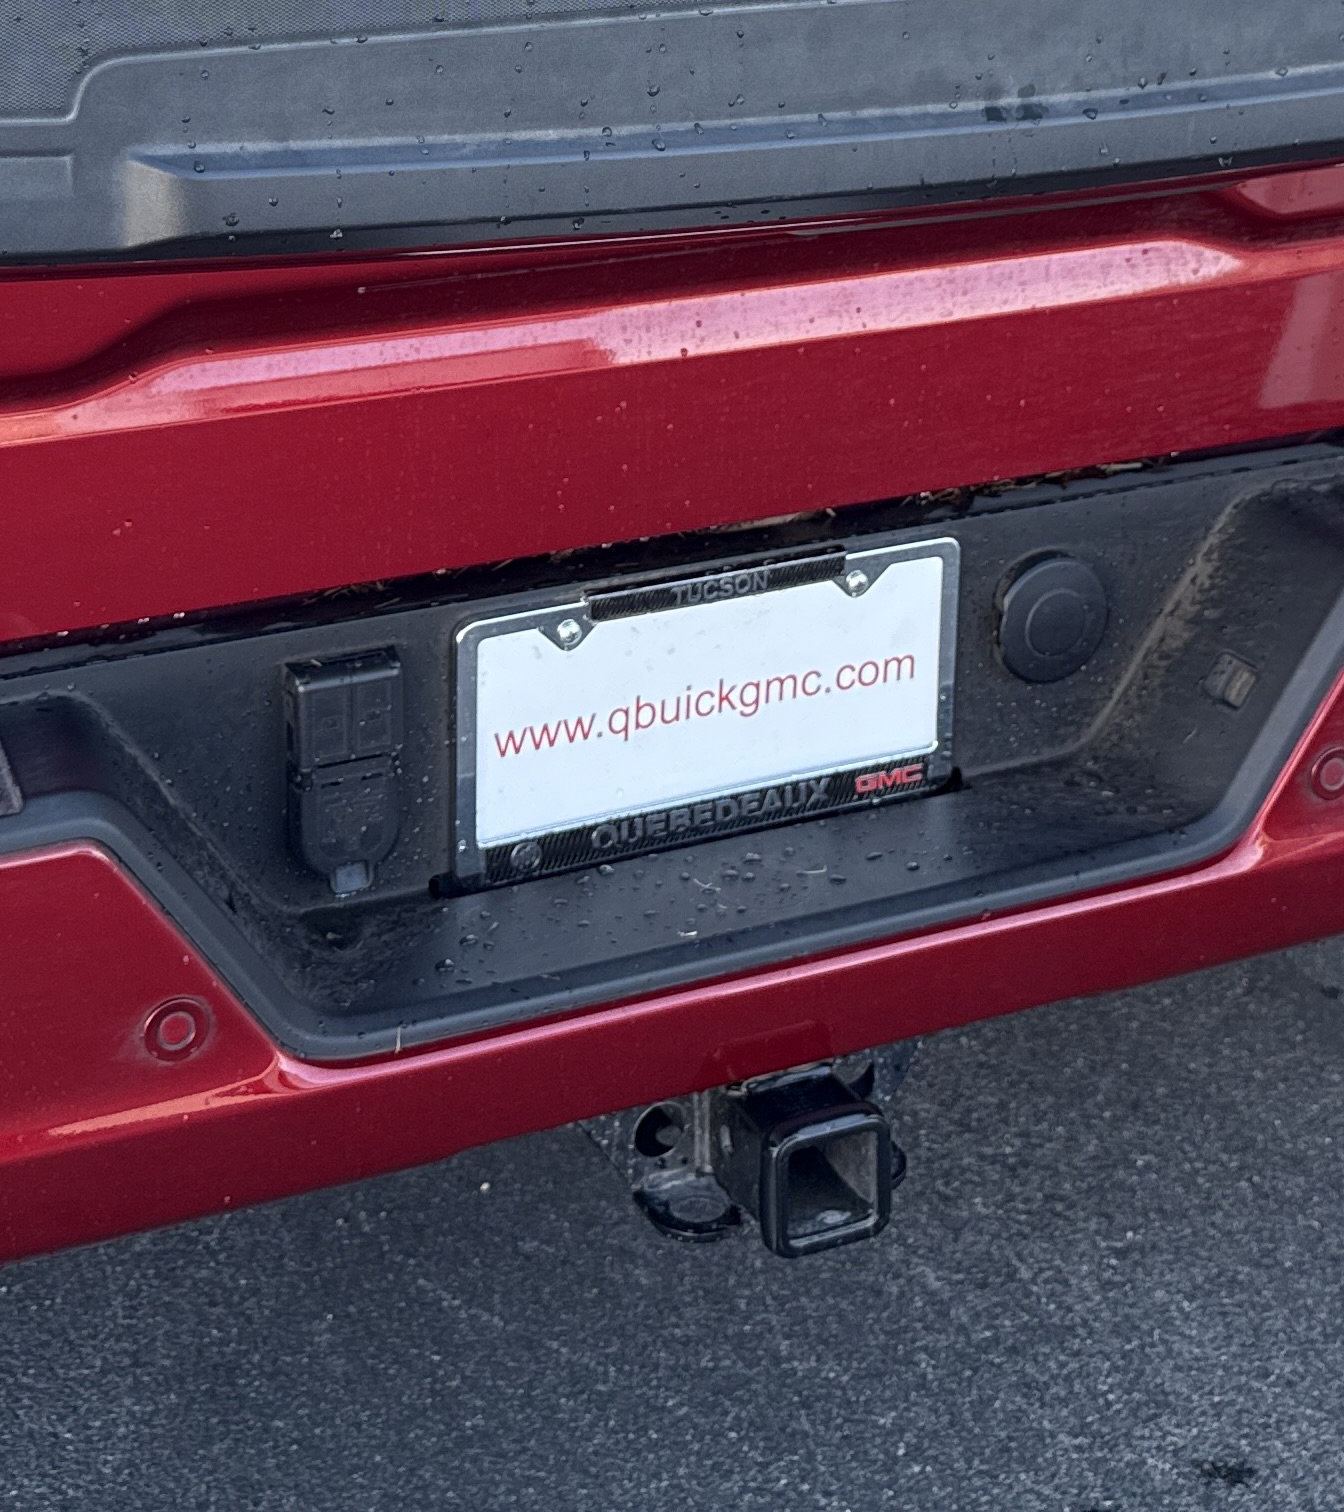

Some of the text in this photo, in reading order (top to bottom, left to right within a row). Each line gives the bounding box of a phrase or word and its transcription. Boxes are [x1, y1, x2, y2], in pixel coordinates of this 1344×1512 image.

[670, 571, 769, 605] TUCSON
[494, 649, 916, 759] www.qbuickgmc.com
[590, 763, 923, 851] QUEBEDEAUX GMC
